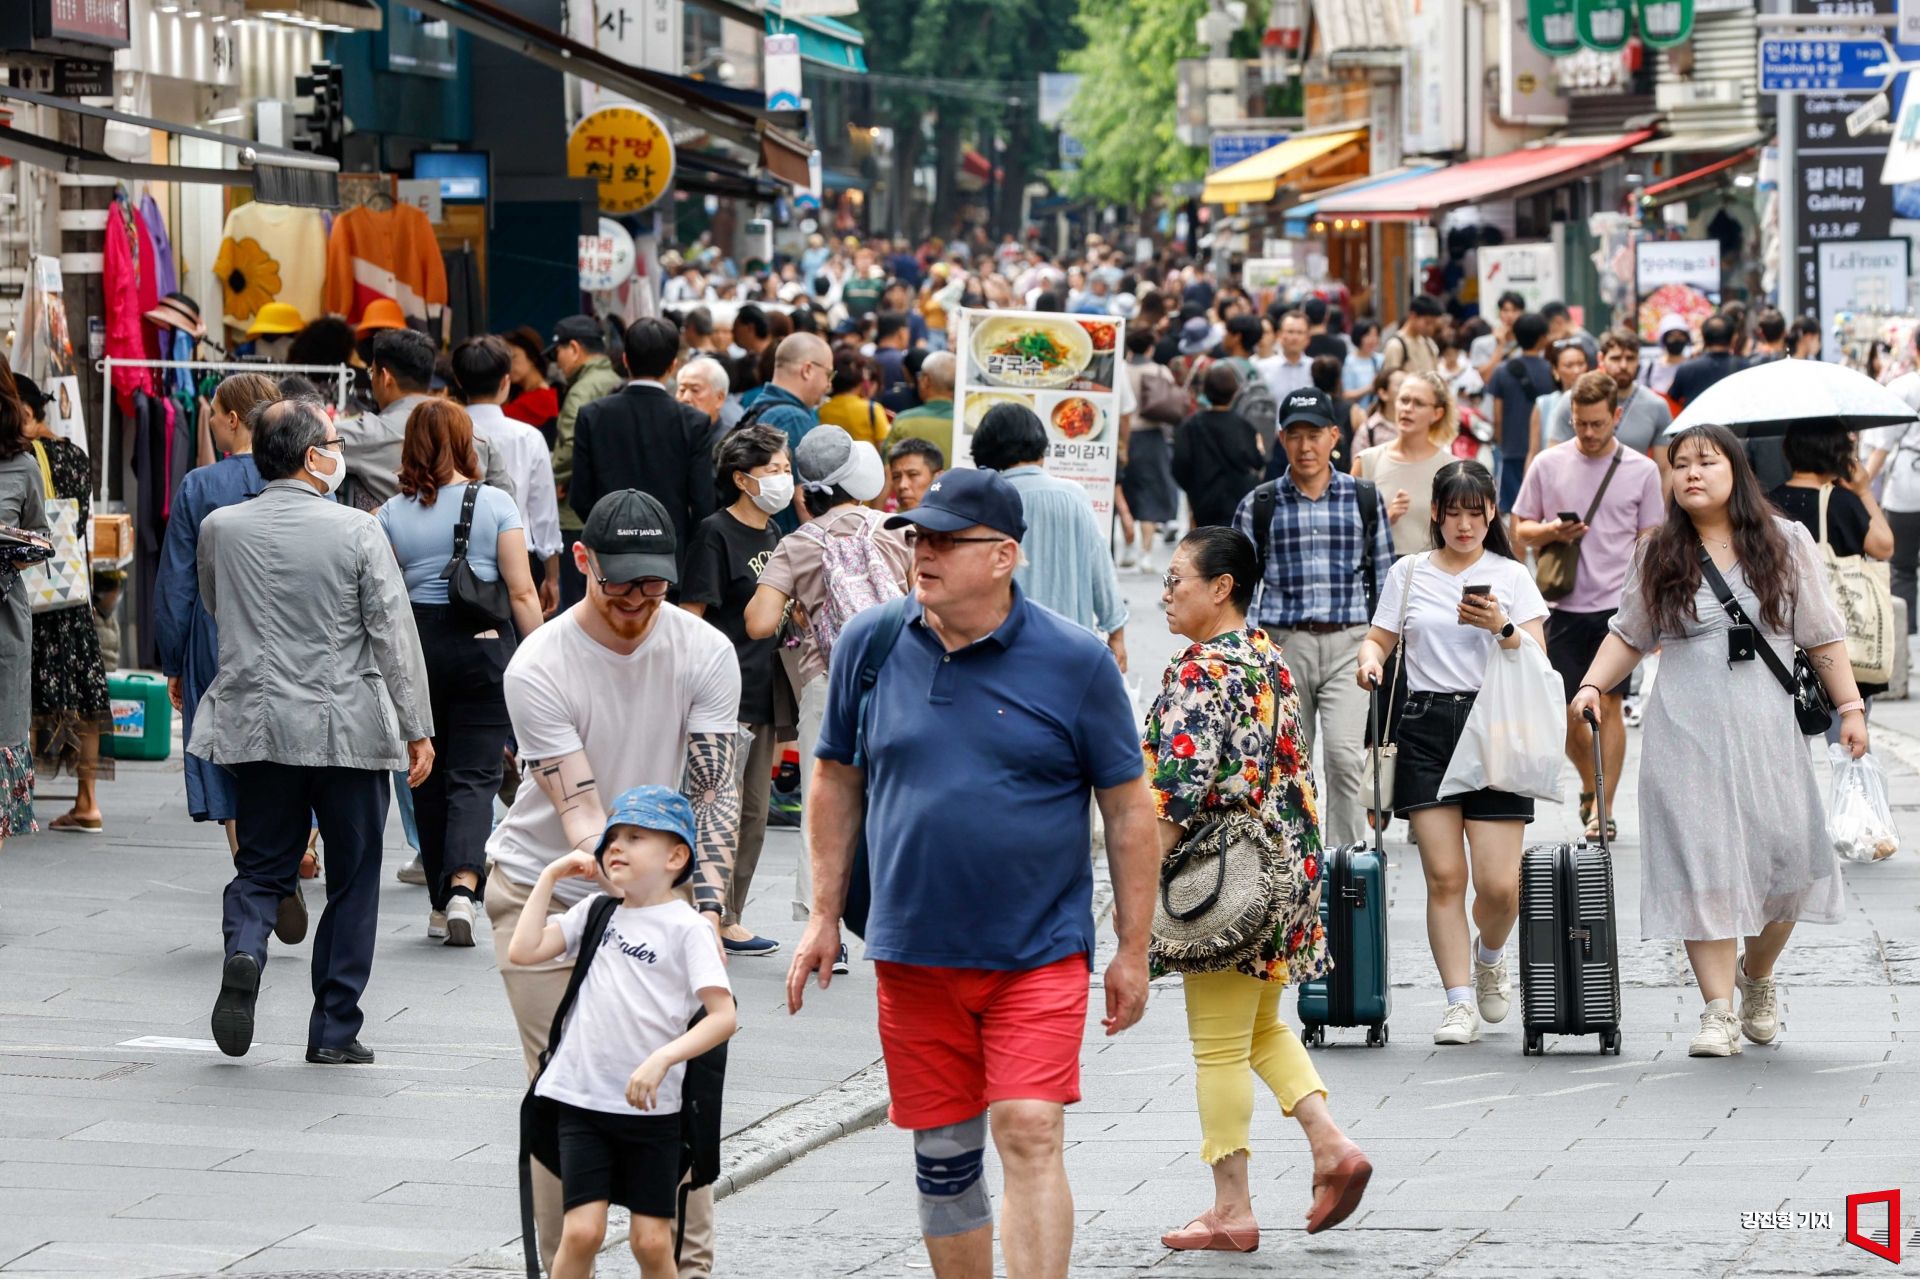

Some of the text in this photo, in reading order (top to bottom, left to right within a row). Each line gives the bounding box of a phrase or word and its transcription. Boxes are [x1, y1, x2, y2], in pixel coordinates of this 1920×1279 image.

[1766, 62, 1815, 76] Insadong
[585, 135, 653, 159] 작명
[1806, 166, 1864, 190] 갤러리
[1807, 194, 1866, 213] Gallery
[987, 355, 1044, 376] 칼국수
